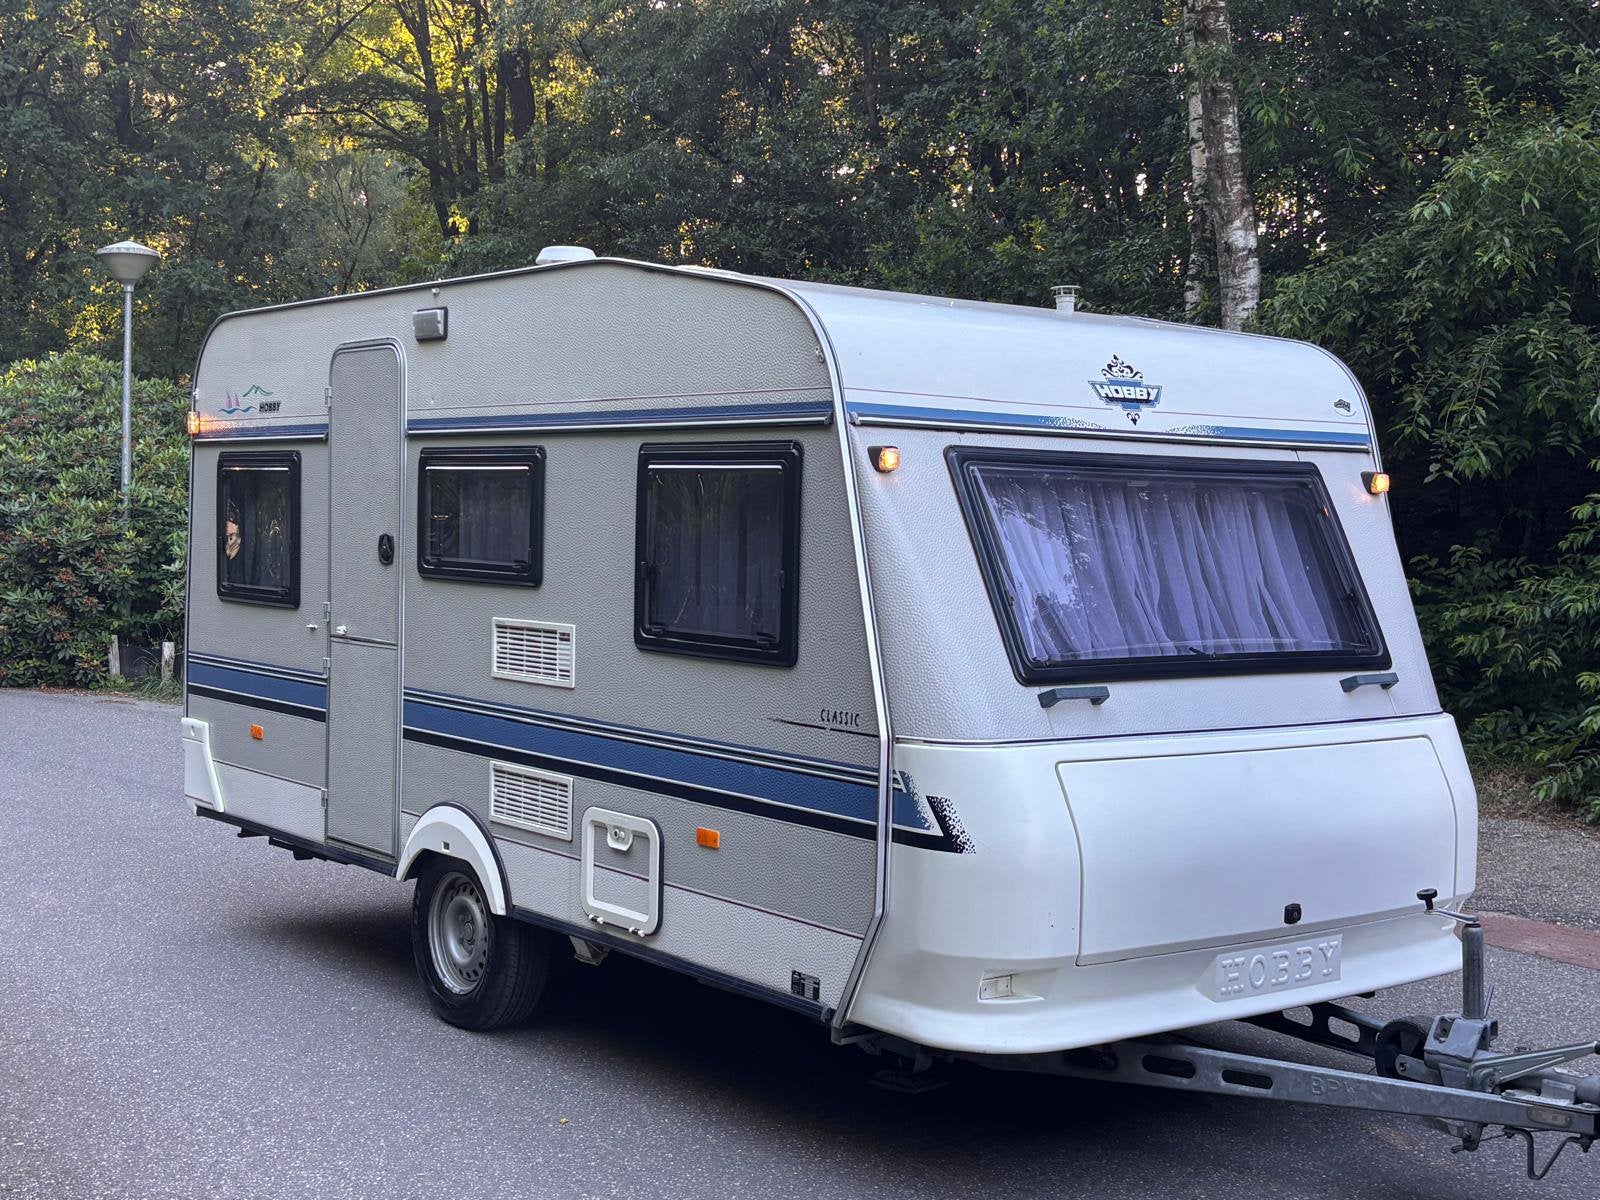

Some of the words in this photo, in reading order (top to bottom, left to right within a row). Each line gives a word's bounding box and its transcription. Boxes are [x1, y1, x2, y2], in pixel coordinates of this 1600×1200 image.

[1095, 383, 1159, 400] HOBBY
[259, 401, 281, 412] HOBBY
[820, 708, 860, 727] CLASSIC
[1220, 941, 1339, 995] HOBBY
